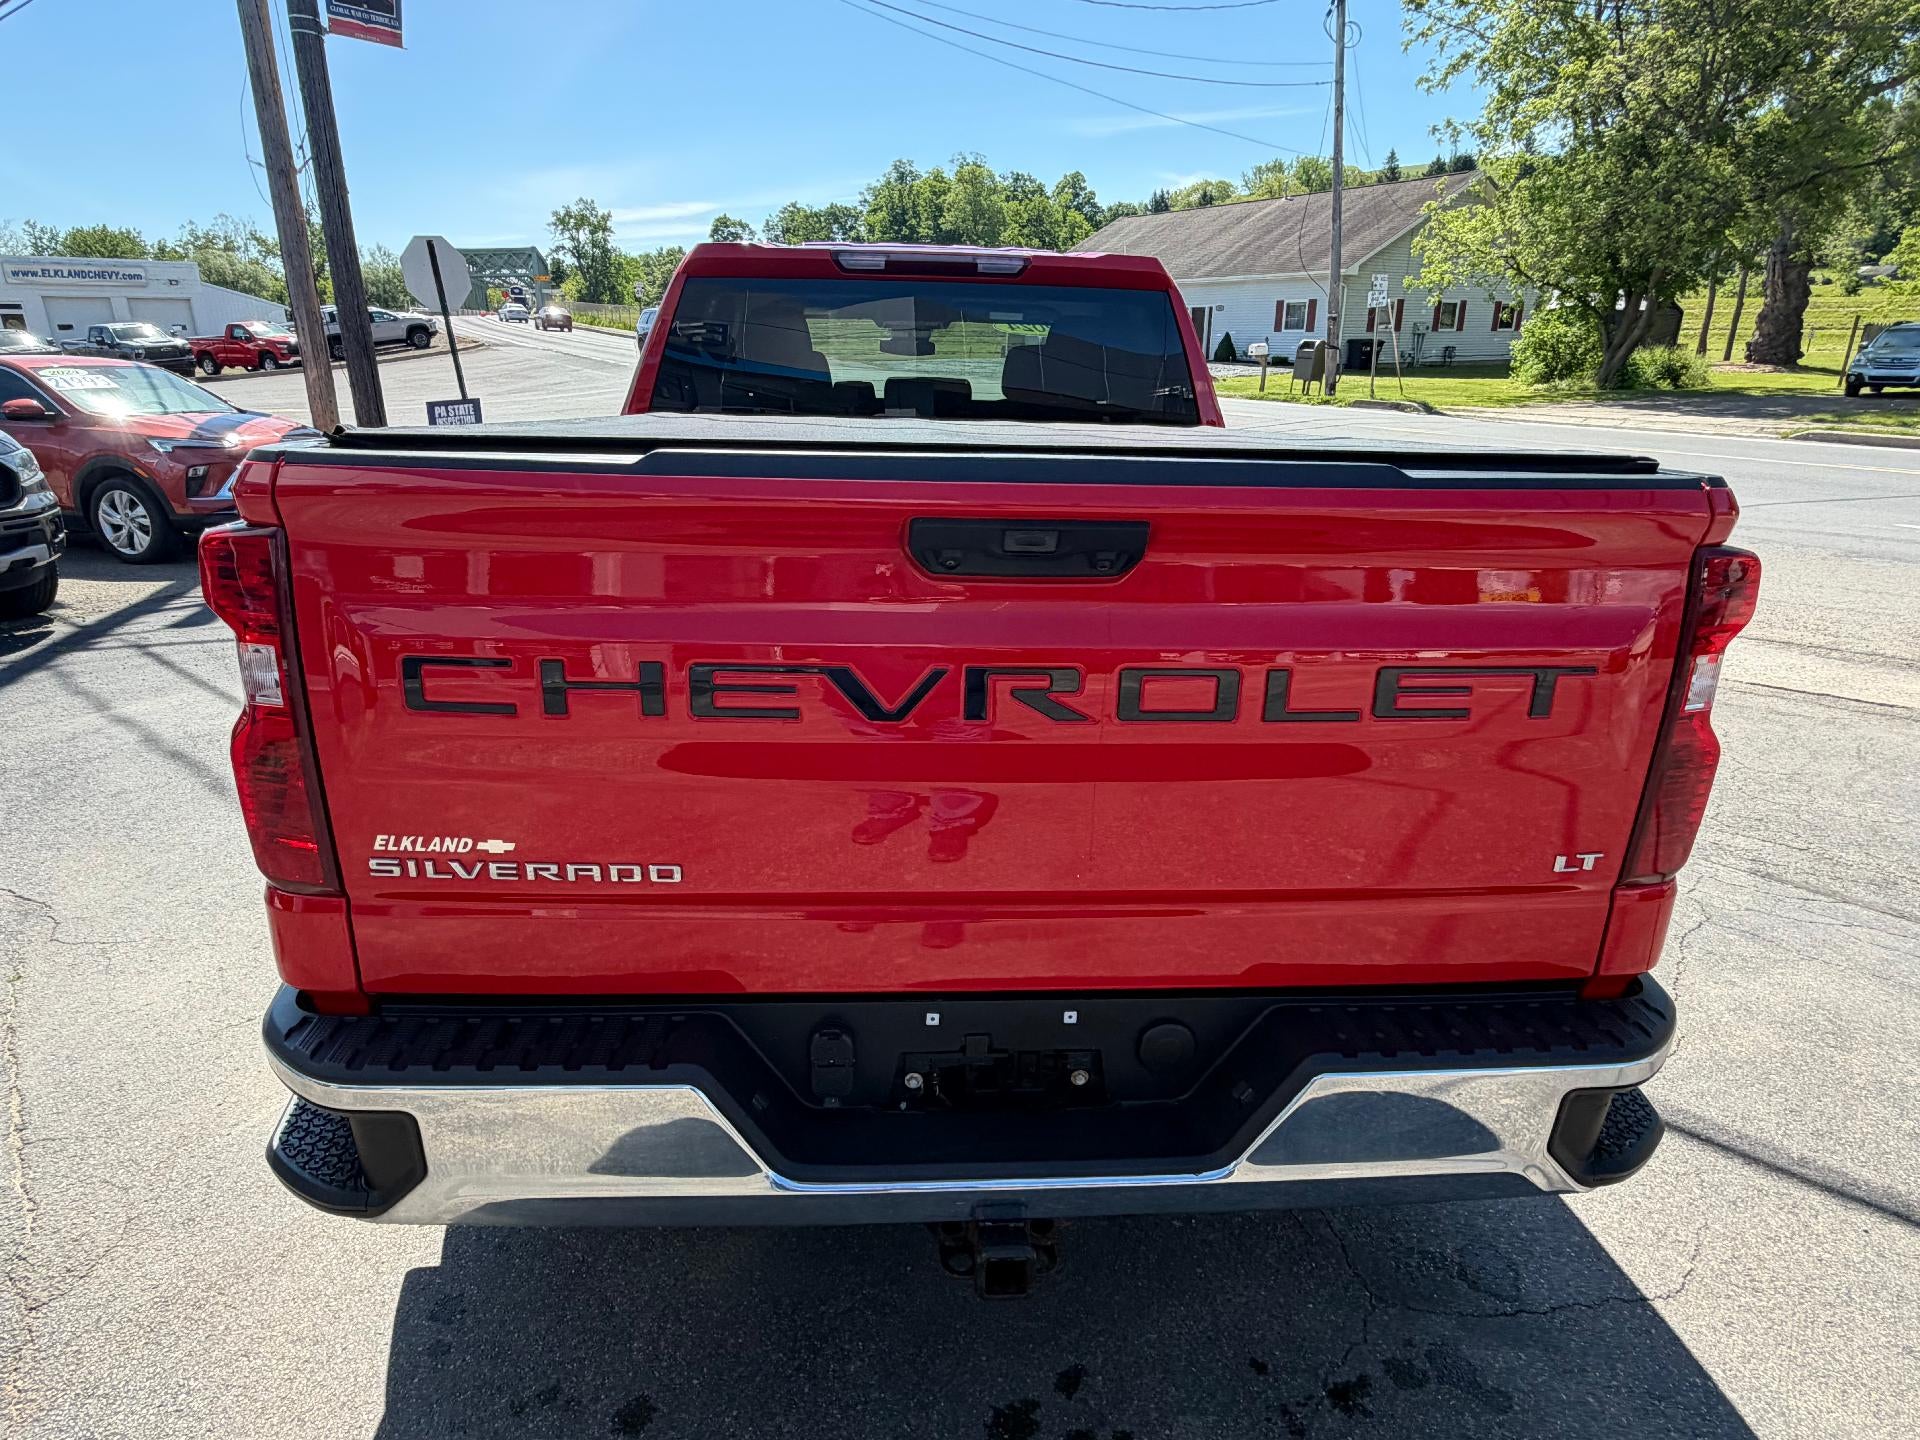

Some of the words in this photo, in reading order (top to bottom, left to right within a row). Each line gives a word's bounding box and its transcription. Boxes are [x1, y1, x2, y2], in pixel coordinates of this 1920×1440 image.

[10, 268, 143, 280] www.ELKLANDCHEVY.com
[434, 405, 447, 418] PA
[447, 403, 475, 417] STATE
[435, 414, 476, 426] INSPECTION
[402, 654, 1598, 723] CHEVROLET
[373, 834, 473, 853] ELKLAND
[368, 856, 683, 883] SILVERADO
[1553, 853, 1605, 873] LT
